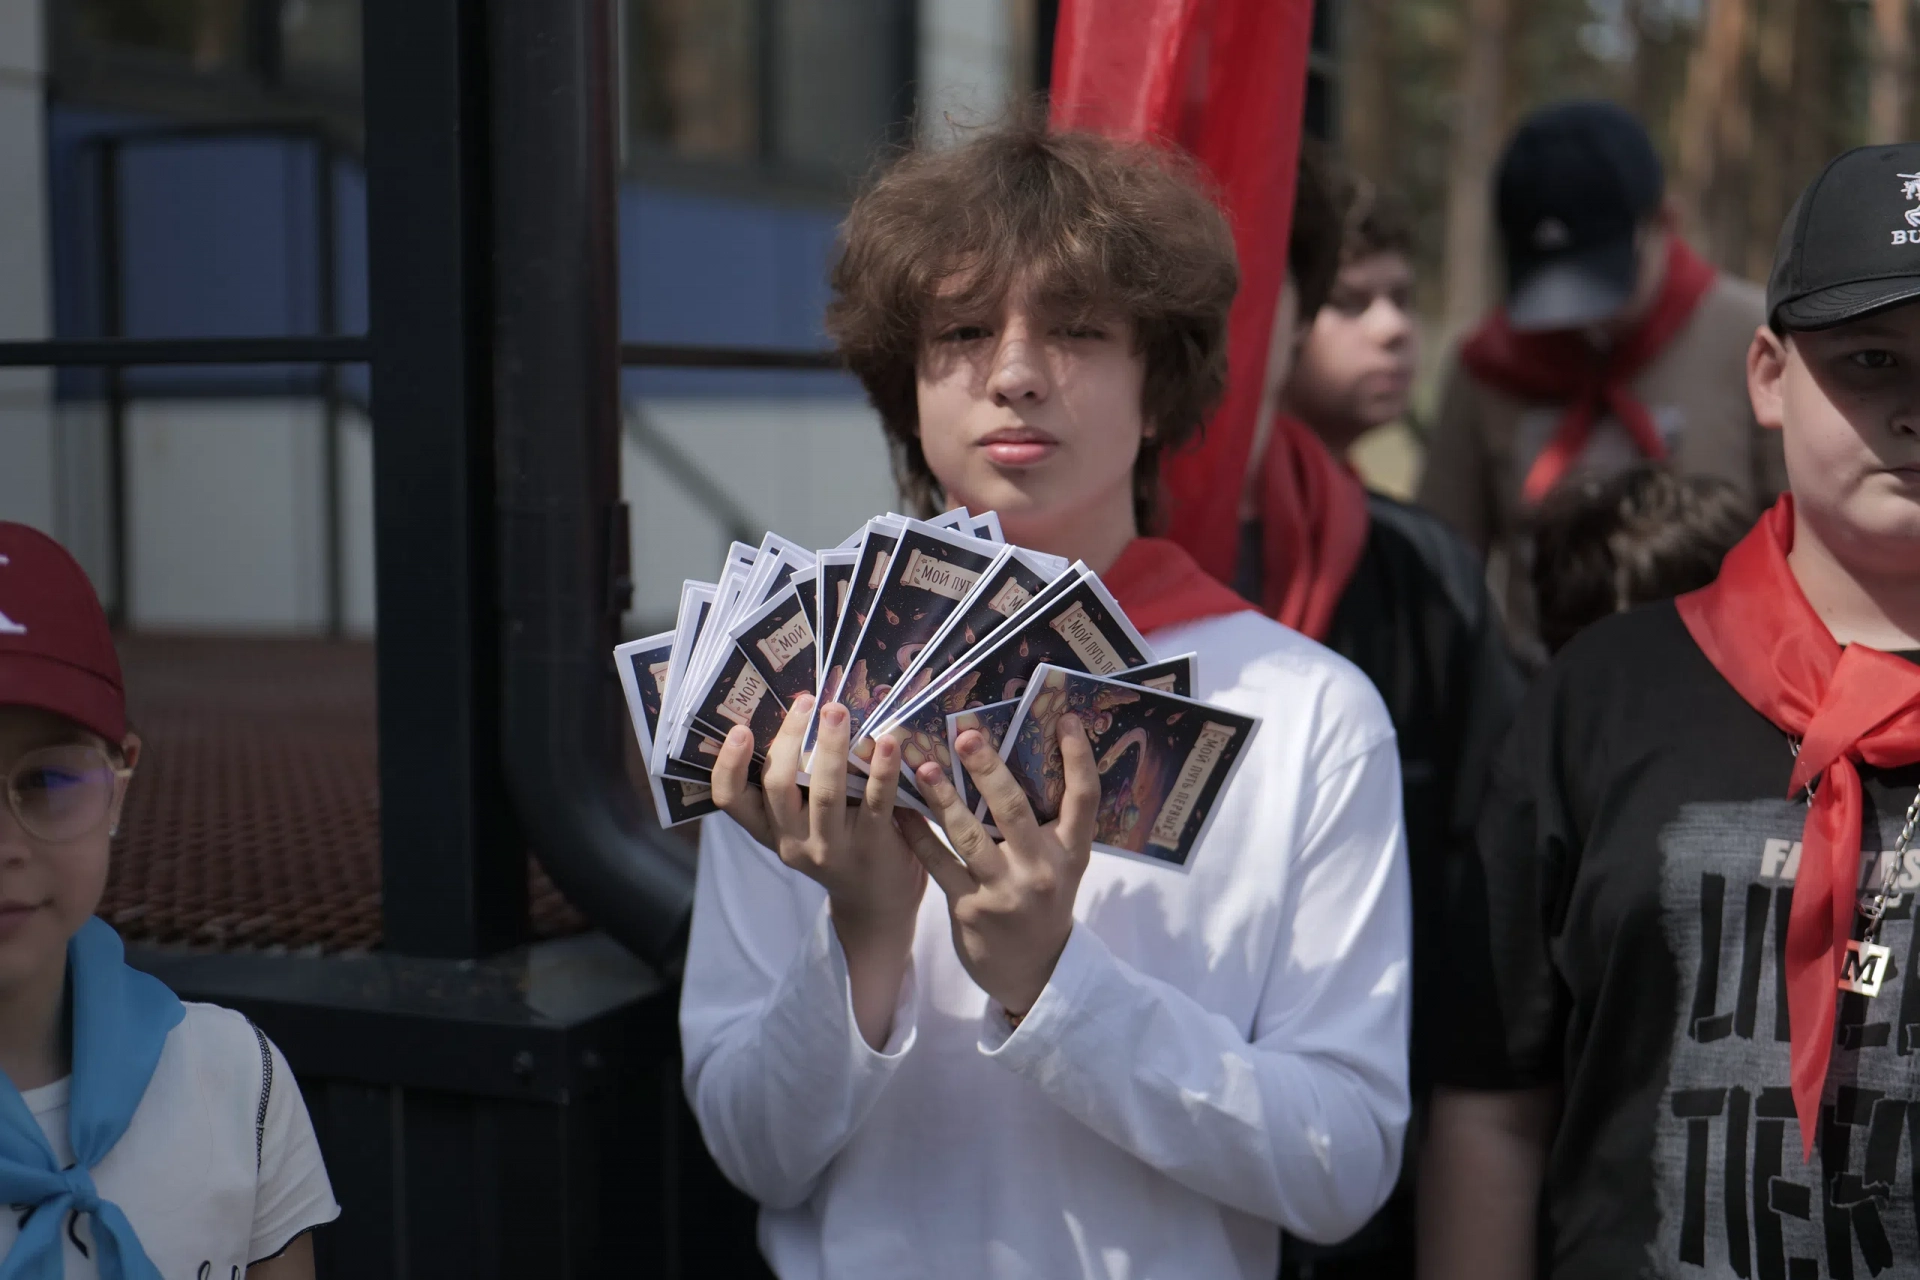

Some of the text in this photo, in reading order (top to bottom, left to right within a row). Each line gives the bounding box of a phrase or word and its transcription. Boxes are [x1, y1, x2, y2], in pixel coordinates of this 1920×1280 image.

[921, 564, 975, 593] МОЙ ПУТ
[778, 623, 807, 651] МОЙ
[1067, 619, 1094, 645] МОЙ
[1084, 641, 1106, 665] ПУТЬ
[735, 676, 761, 707] МОЙ
[1162, 738, 1219, 831] МОЙ ПУТЬ ПЕРВЫХ
[1840, 948, 1883, 985] M
